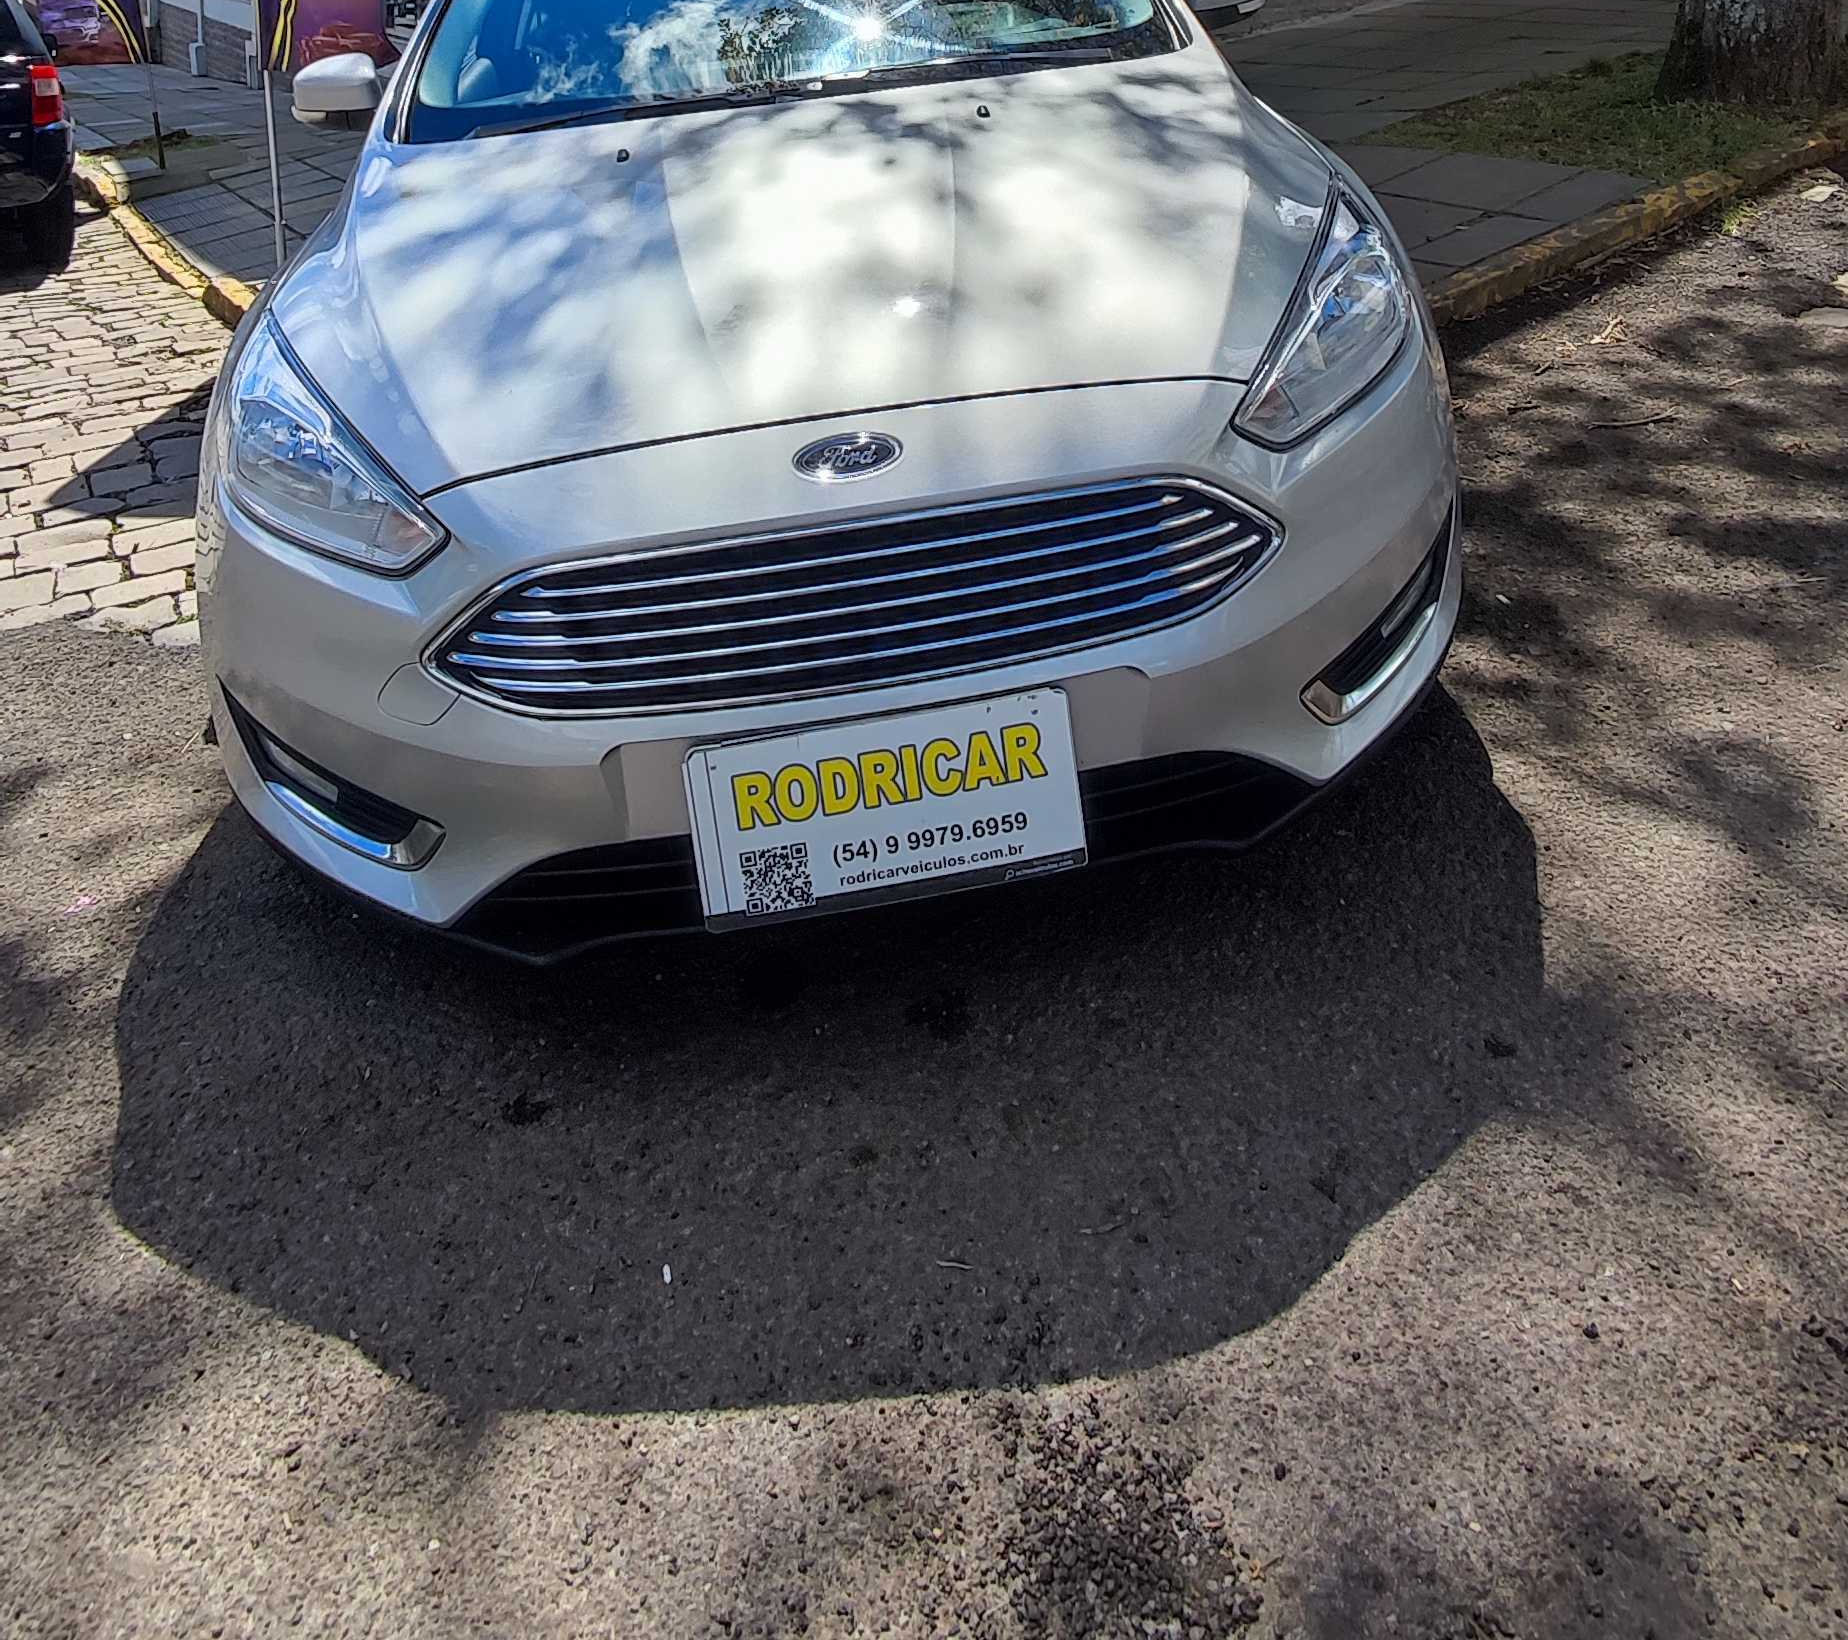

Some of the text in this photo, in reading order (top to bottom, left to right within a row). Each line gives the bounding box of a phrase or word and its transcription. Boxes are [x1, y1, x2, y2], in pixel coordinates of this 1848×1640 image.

[731, 722, 1048, 832] RODRICAR
[832, 811, 1029, 868] (54) 9 9979.6959
[839, 843, 1025, 887] rodricarveiculos.com.br
